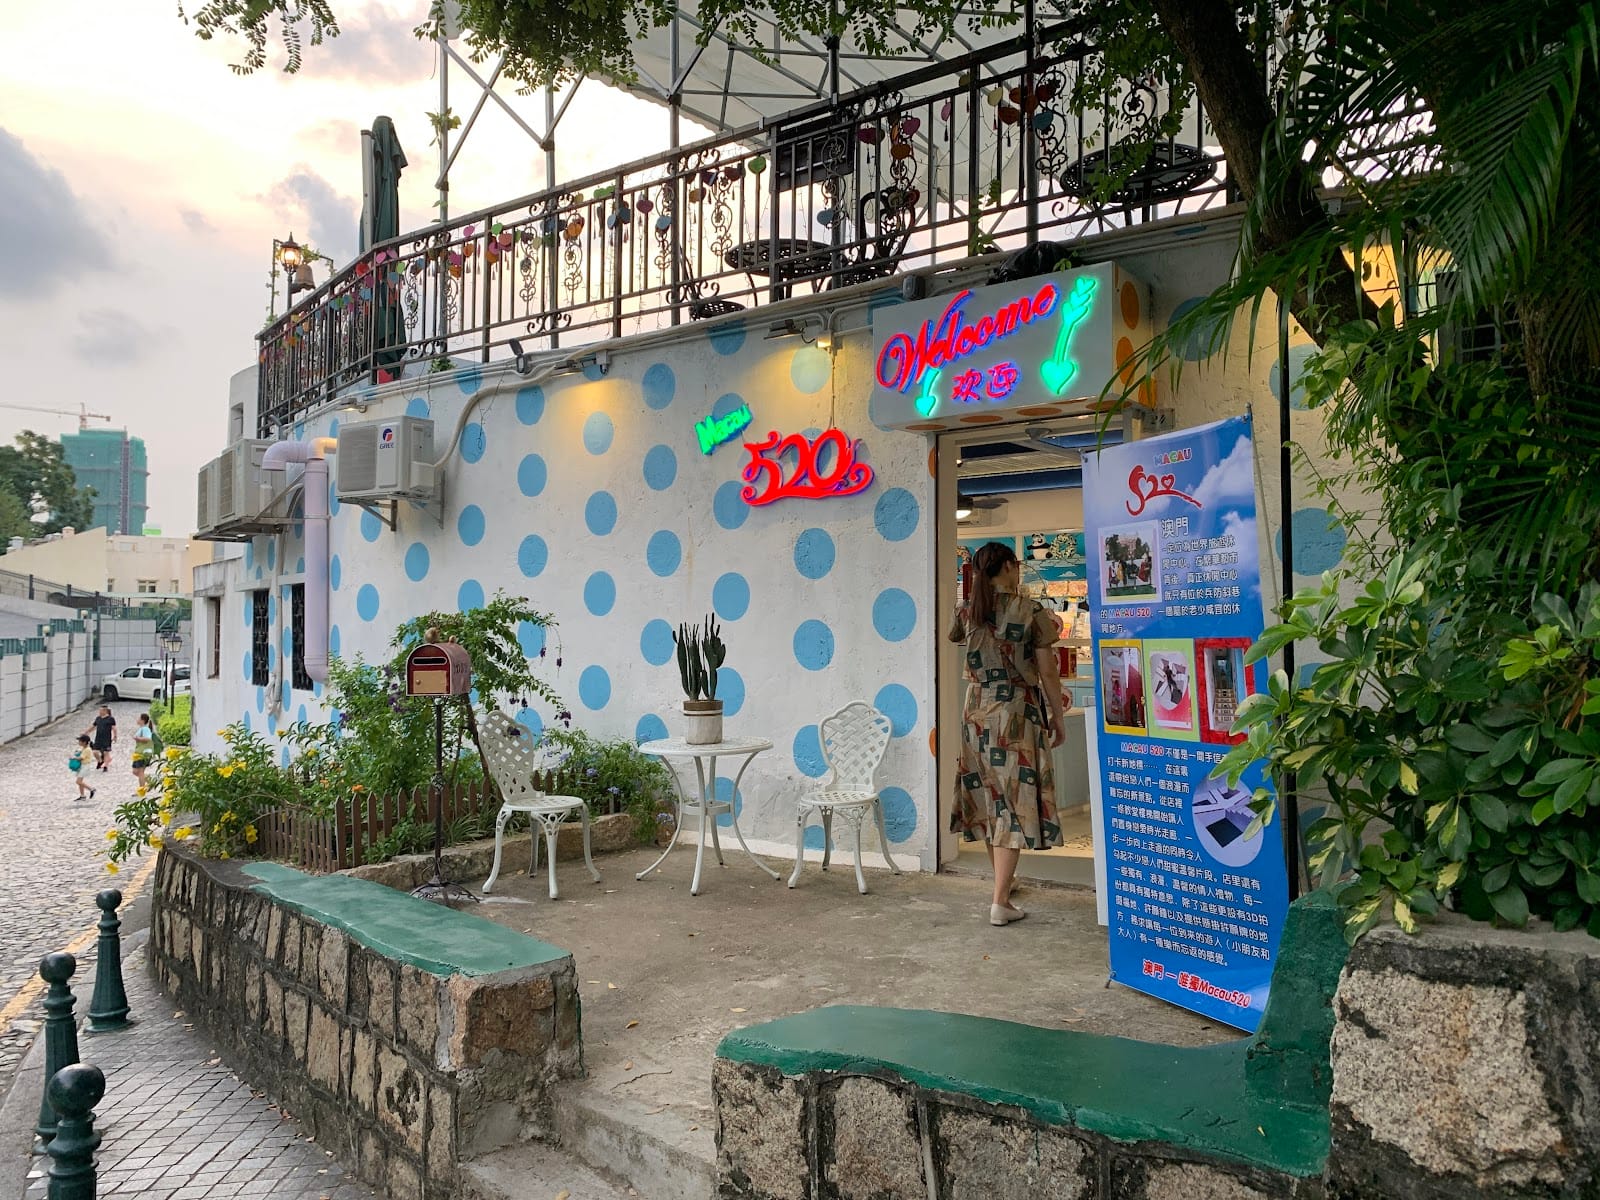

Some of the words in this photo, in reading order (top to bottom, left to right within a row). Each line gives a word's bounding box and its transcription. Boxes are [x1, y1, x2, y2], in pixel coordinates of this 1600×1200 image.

[876, 283, 1060, 393] Welcome
[950, 361, 1019, 402] 欢迎
[740, 428, 875, 507] 520
[1153, 447, 1192, 466] MACAU
[1161, 516, 1189, 538] 澳門
[1108, 608, 1135, 618] MACAU
[1120, 742, 1148, 754] MACAU
[1149, 744, 1164, 756] 520
[1142, 958, 1165, 980] 澳門
